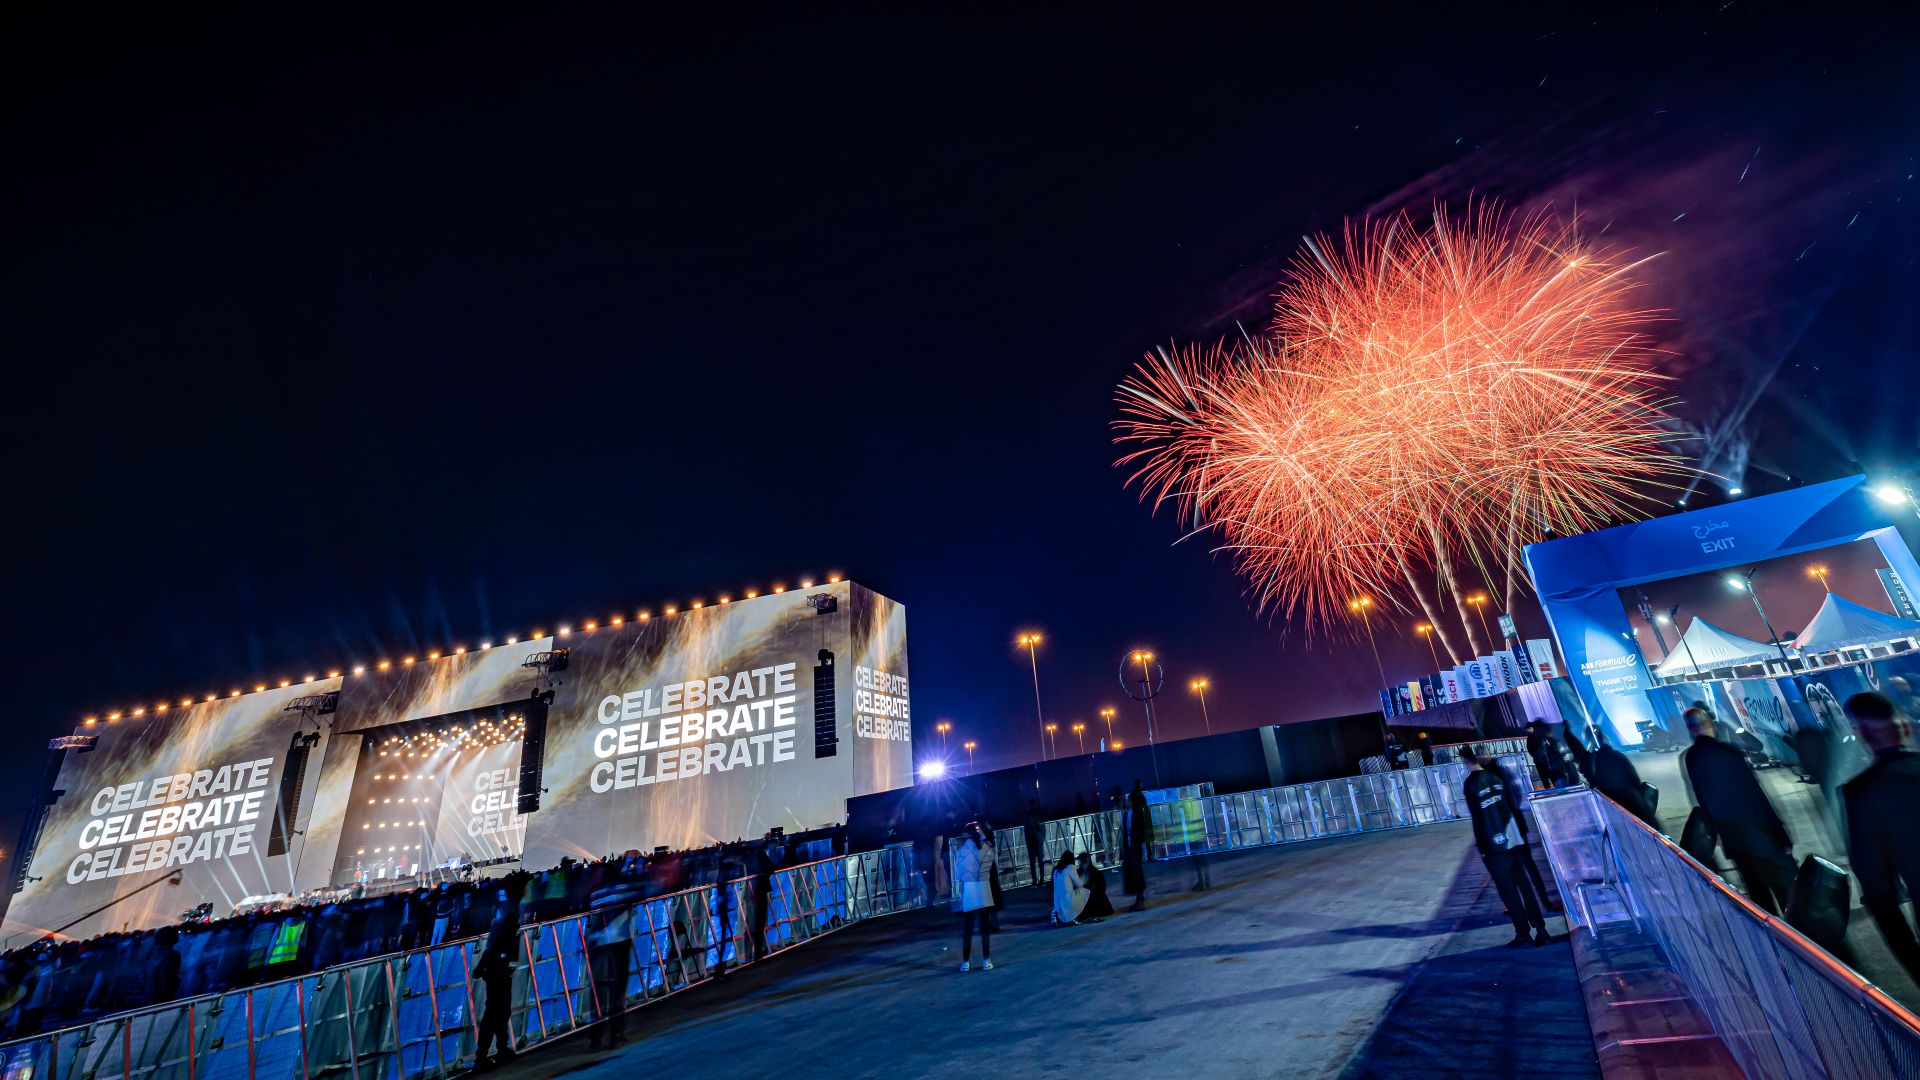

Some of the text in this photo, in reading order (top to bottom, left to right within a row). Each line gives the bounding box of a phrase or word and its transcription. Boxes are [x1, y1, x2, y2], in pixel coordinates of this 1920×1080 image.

[1691, 519, 1730, 539] مخرج
[1700, 536, 1735, 554] EXIT
[1595, 656, 1626, 668] FORMULA
[598, 662, 796, 725] CELEBRATE
[855, 665, 908, 697] CELEBRATE
[1596, 674, 1638, 686] THANK YOU
[855, 690, 909, 719] CELEBRATE
[594, 695, 797, 759] CELEBRATE
[856, 715, 910, 742] CELEBRATE
[590, 729, 796, 794] CELEBRATE
[90, 757, 274, 817] CELEBRATE
[78, 789, 265, 851] CELEBRATE
[66, 823, 256, 886] CELEBRATE
